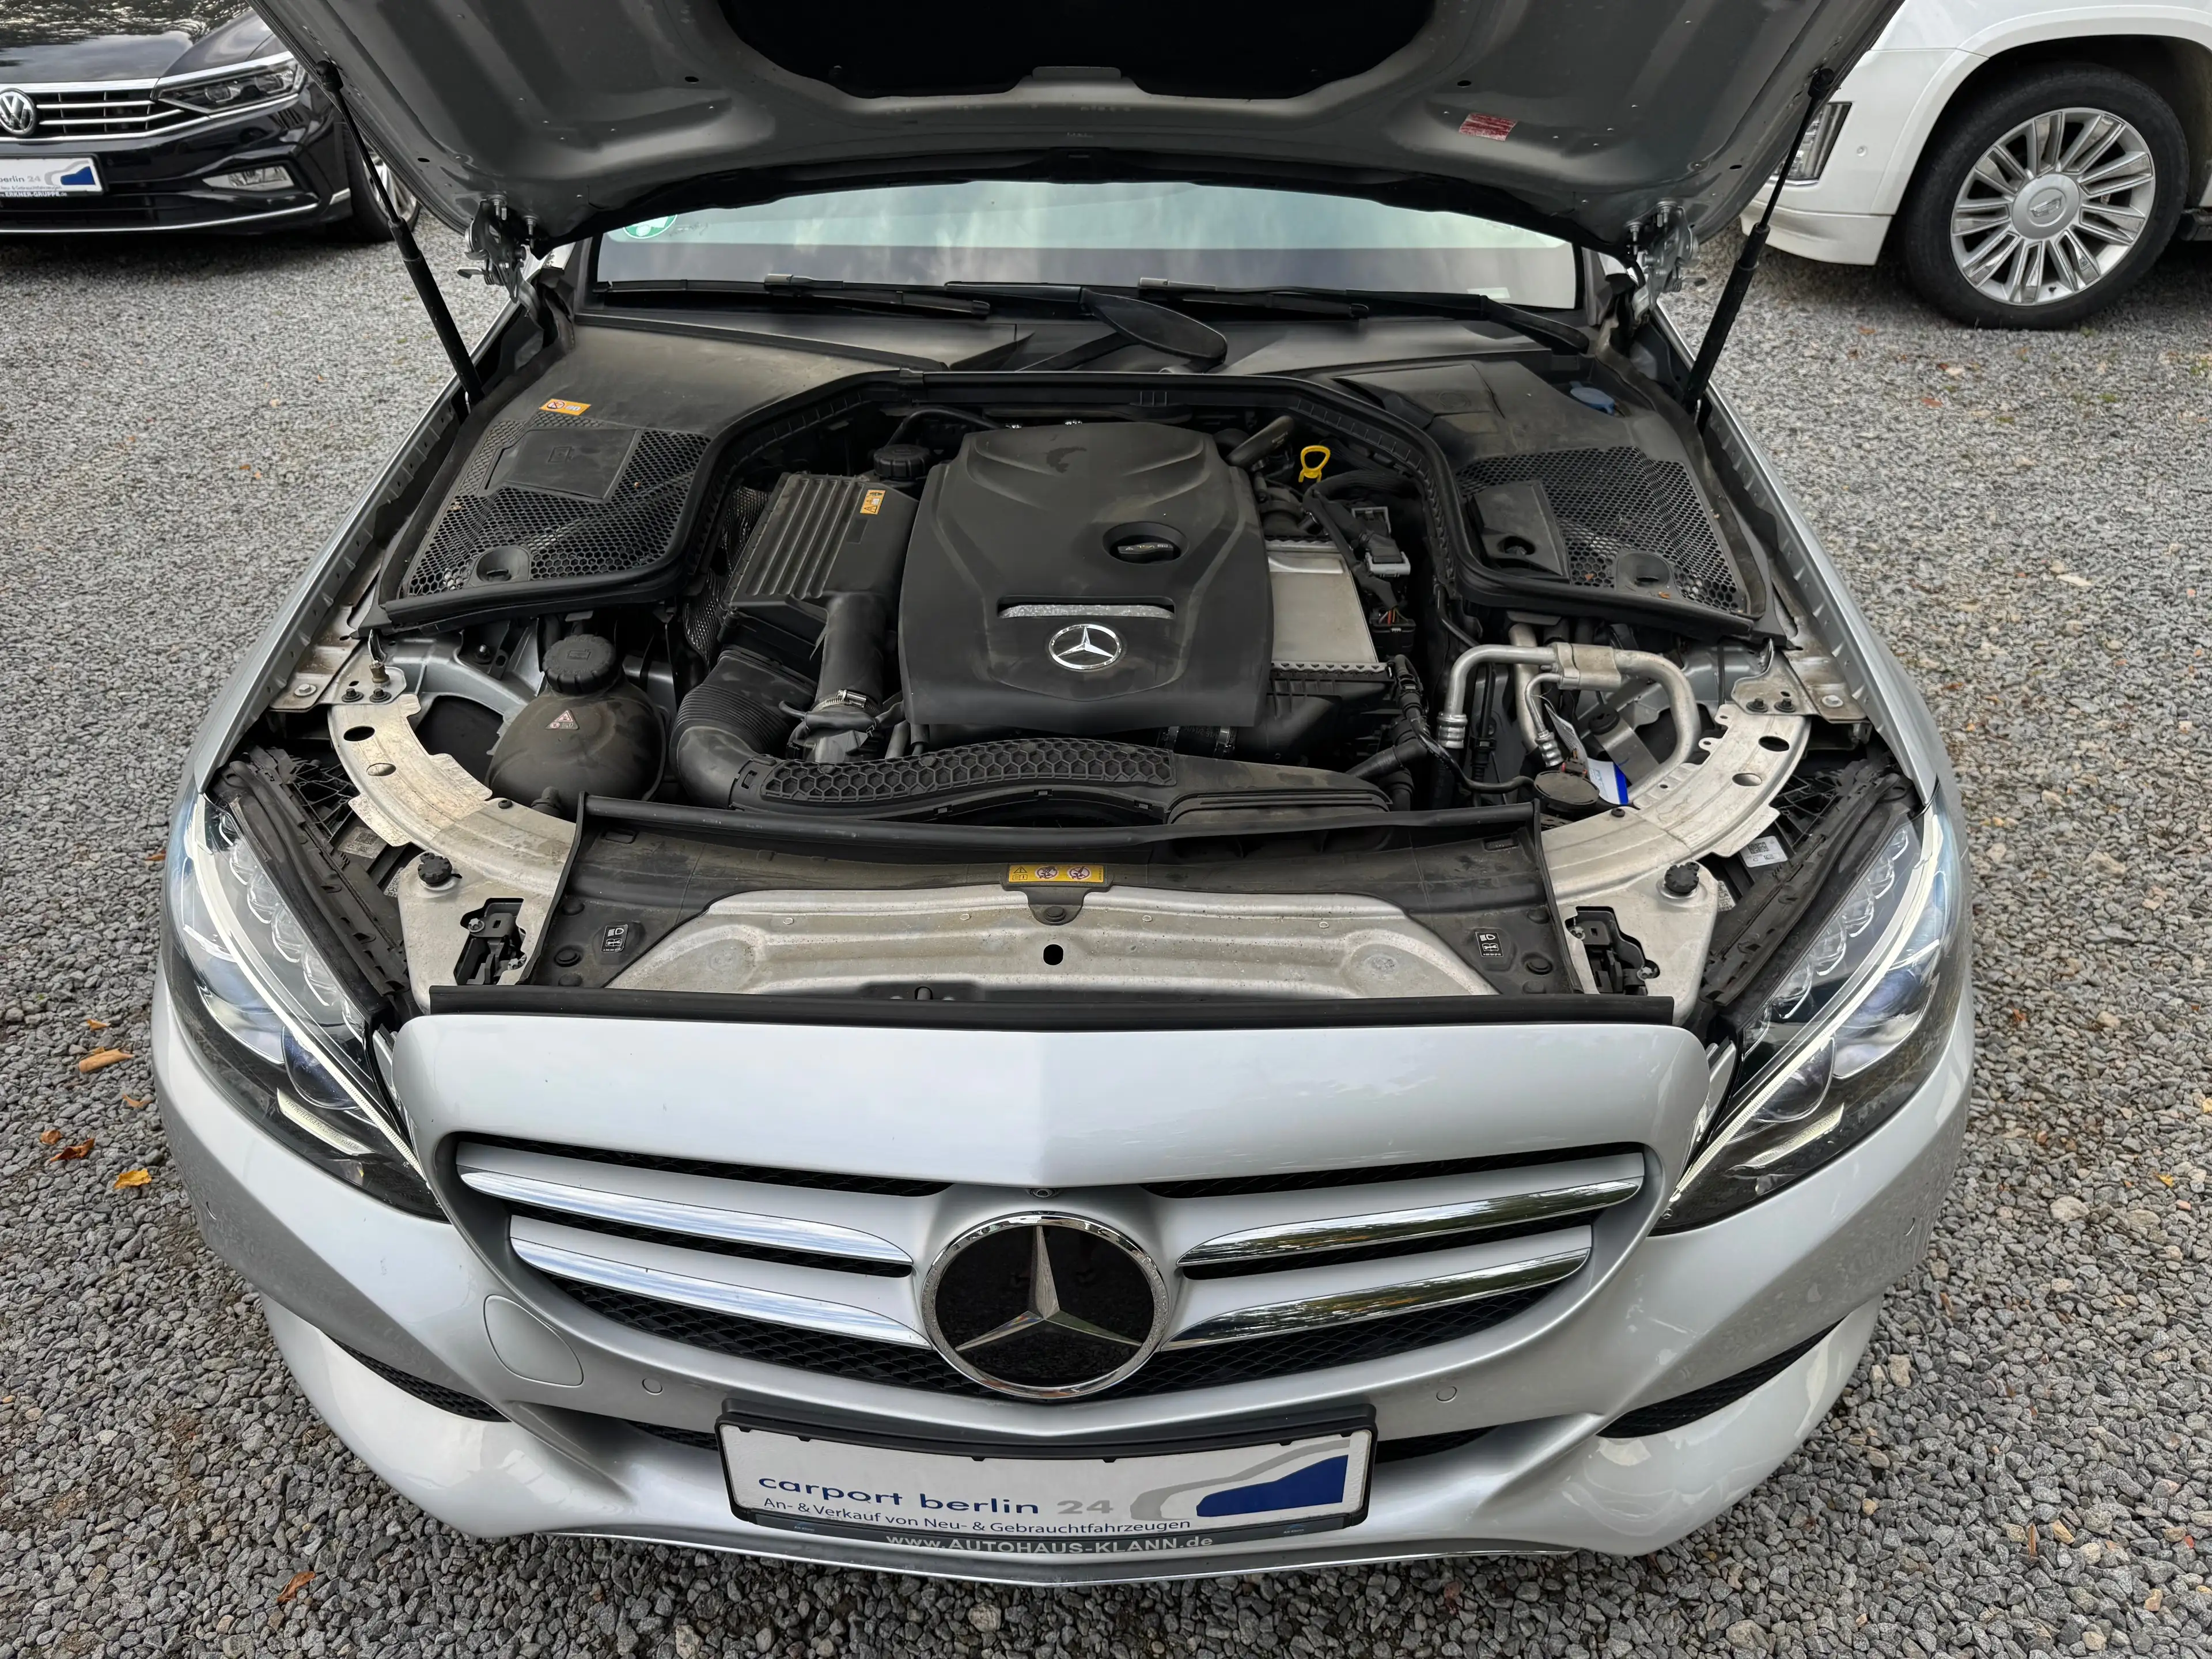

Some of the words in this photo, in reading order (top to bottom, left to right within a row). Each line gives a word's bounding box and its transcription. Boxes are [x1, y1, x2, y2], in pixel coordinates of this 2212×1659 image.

[758, 1478, 903, 1505] carport
[920, 1493, 1039, 1514] berlin
[1057, 1500, 1113, 1514] 24
[764, 1498, 793, 1509] An-
[798, 1503, 810, 1513] &
[813, 1505, 881, 1522] Verkauf
[885, 1516, 918, 1526] von
[925, 1518, 967, 1529] Neu-
[972, 1521, 985, 1531] &
[990, 1520, 1191, 1533] Gebrauchtfahrzeugen
[886, 1536, 1213, 1554] www.AUTOHAUS-KLANN.de
